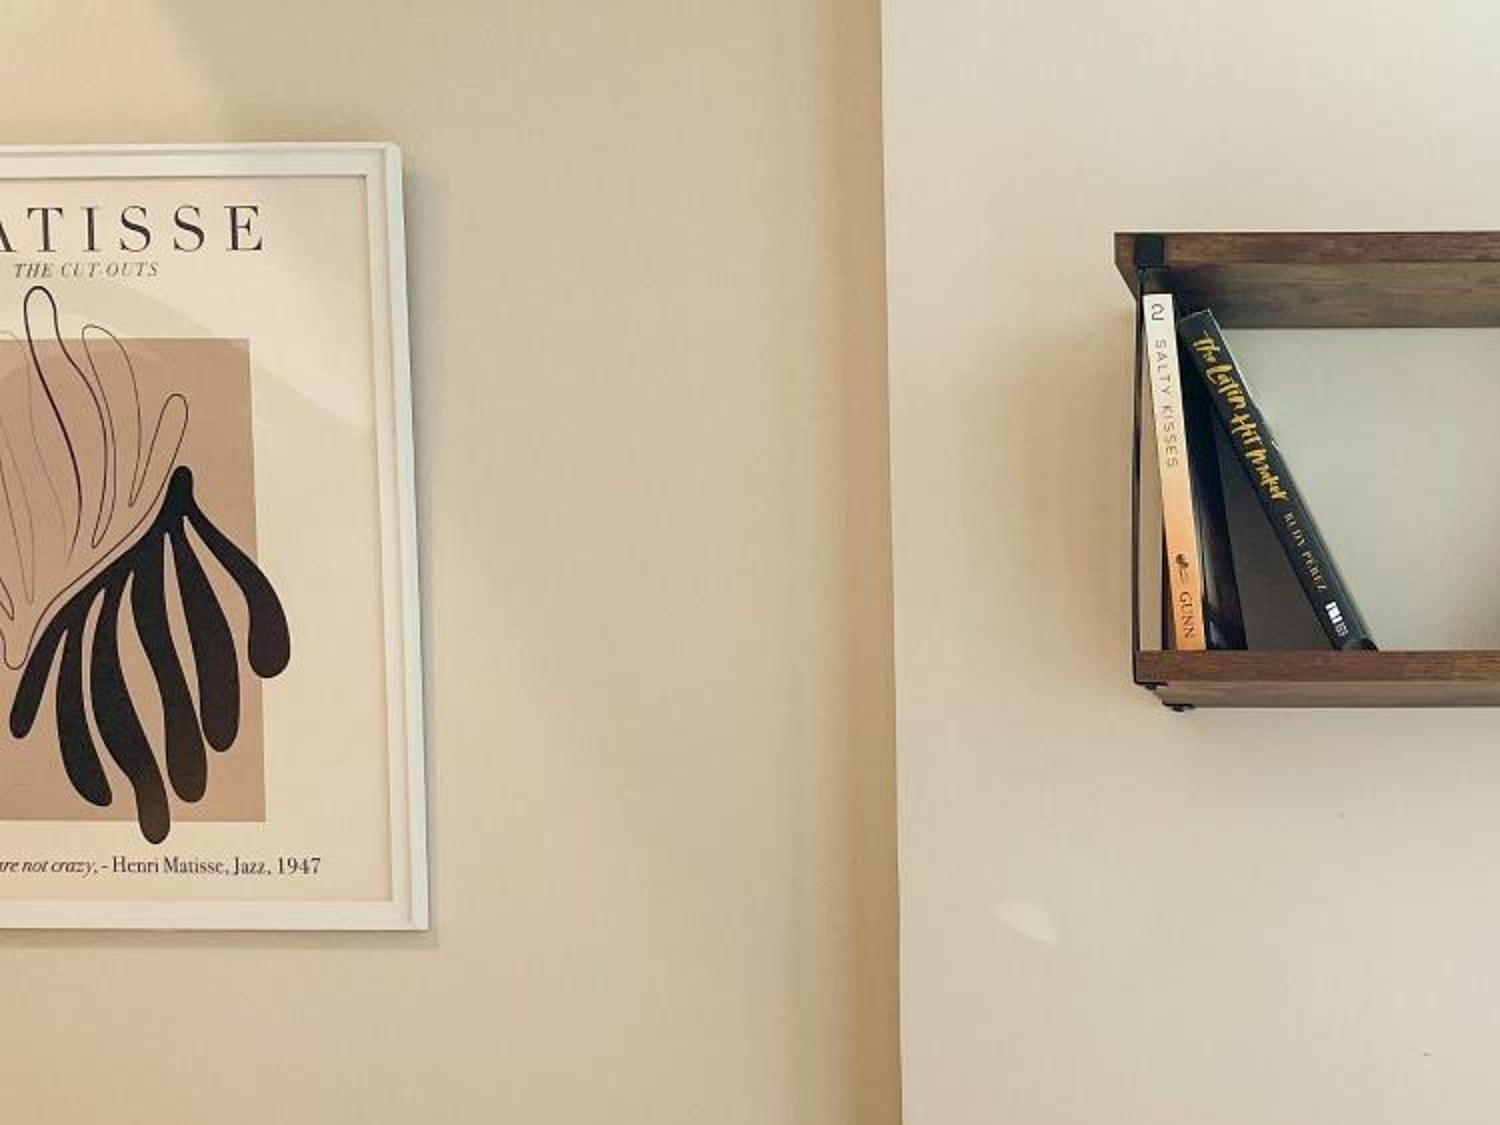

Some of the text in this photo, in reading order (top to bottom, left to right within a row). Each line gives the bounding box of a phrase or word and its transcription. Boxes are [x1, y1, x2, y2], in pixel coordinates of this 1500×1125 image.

[15, 262, 53, 278] THE
[1192, 330, 1220, 363] The
[1206, 363, 1247, 411] Latin
[1155, 339, 1179, 468] SALTY KISSES
[1179, 591, 1195, 639] GUNN
[22, 861, 48, 873] not
[51, 861, 98, 878] crazy,
[113, 856, 159, 873] Henri
[163, 856, 229, 876] Matisse,
[233, 857, 271, 876] Jazz,
[279, 857, 321, 875] 1947
